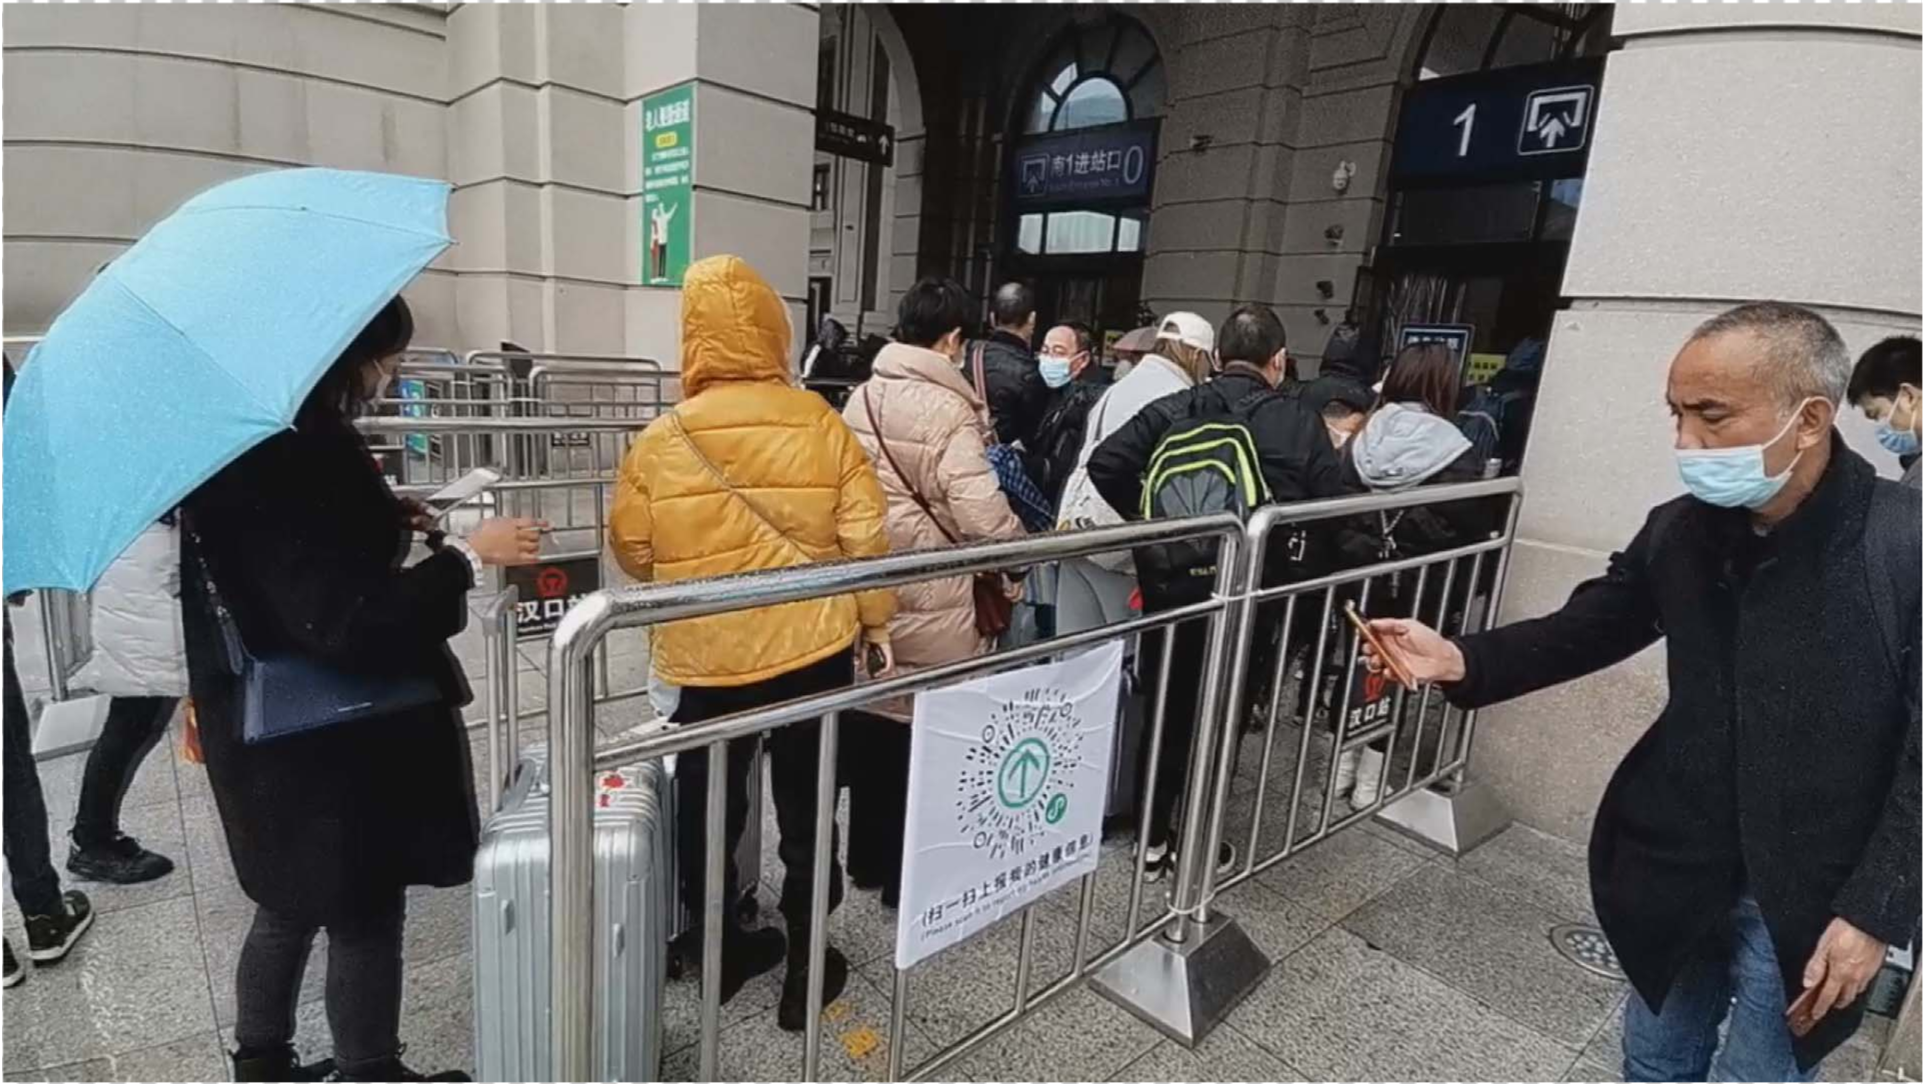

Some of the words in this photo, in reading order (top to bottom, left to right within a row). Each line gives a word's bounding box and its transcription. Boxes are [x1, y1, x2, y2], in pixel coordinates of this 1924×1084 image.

[1453, 103, 1477, 156] 1
[1051, 150, 1121, 177] 南1进站口
[1348, 696, 1390, 728] 汉口站
